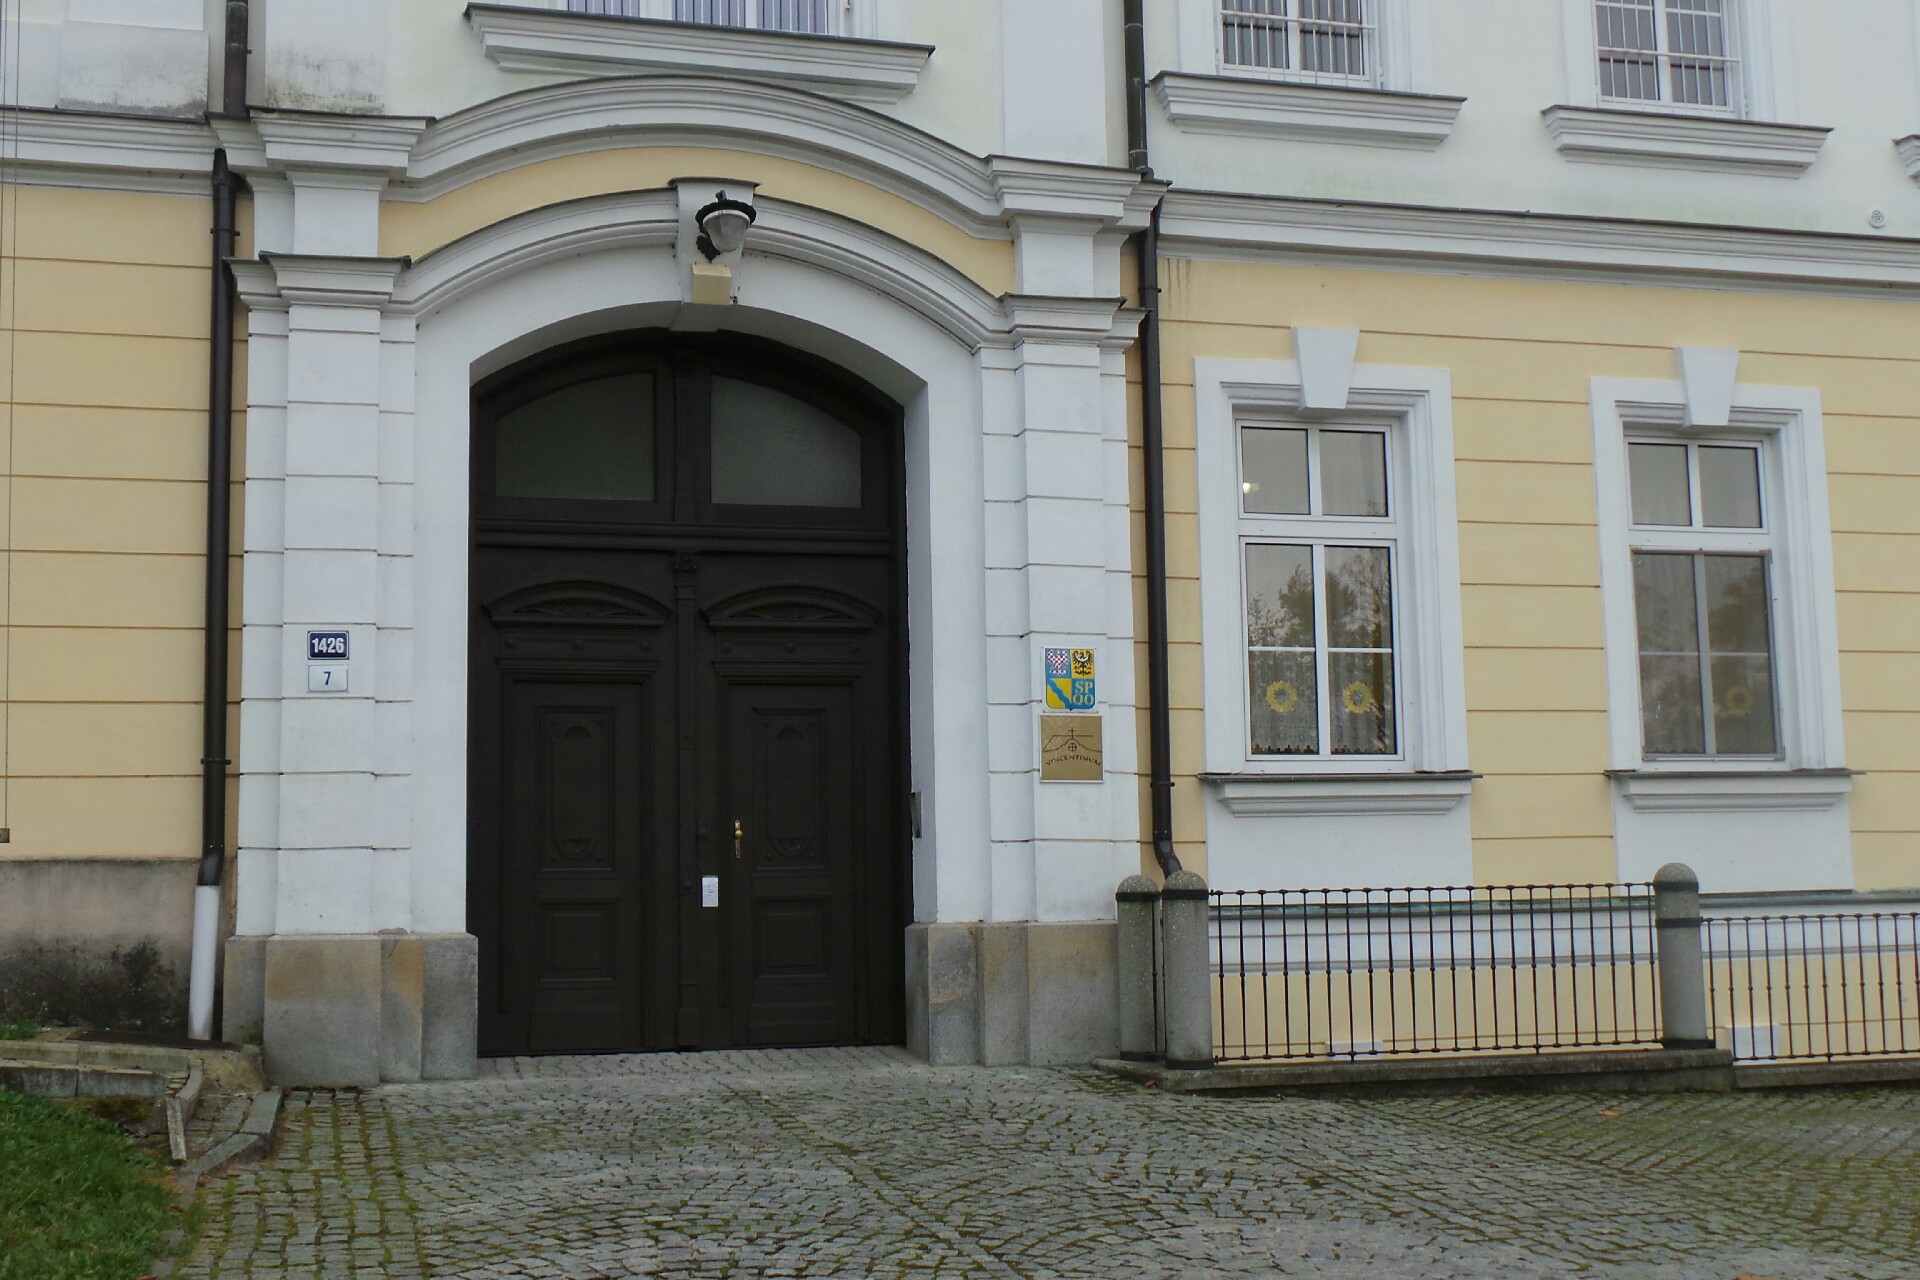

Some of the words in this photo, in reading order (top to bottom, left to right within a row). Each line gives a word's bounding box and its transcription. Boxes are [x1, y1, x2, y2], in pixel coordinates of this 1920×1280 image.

[312, 637, 344, 653] 1426
[324, 671, 331, 685] 7
[1075, 681, 1093, 693] SP
